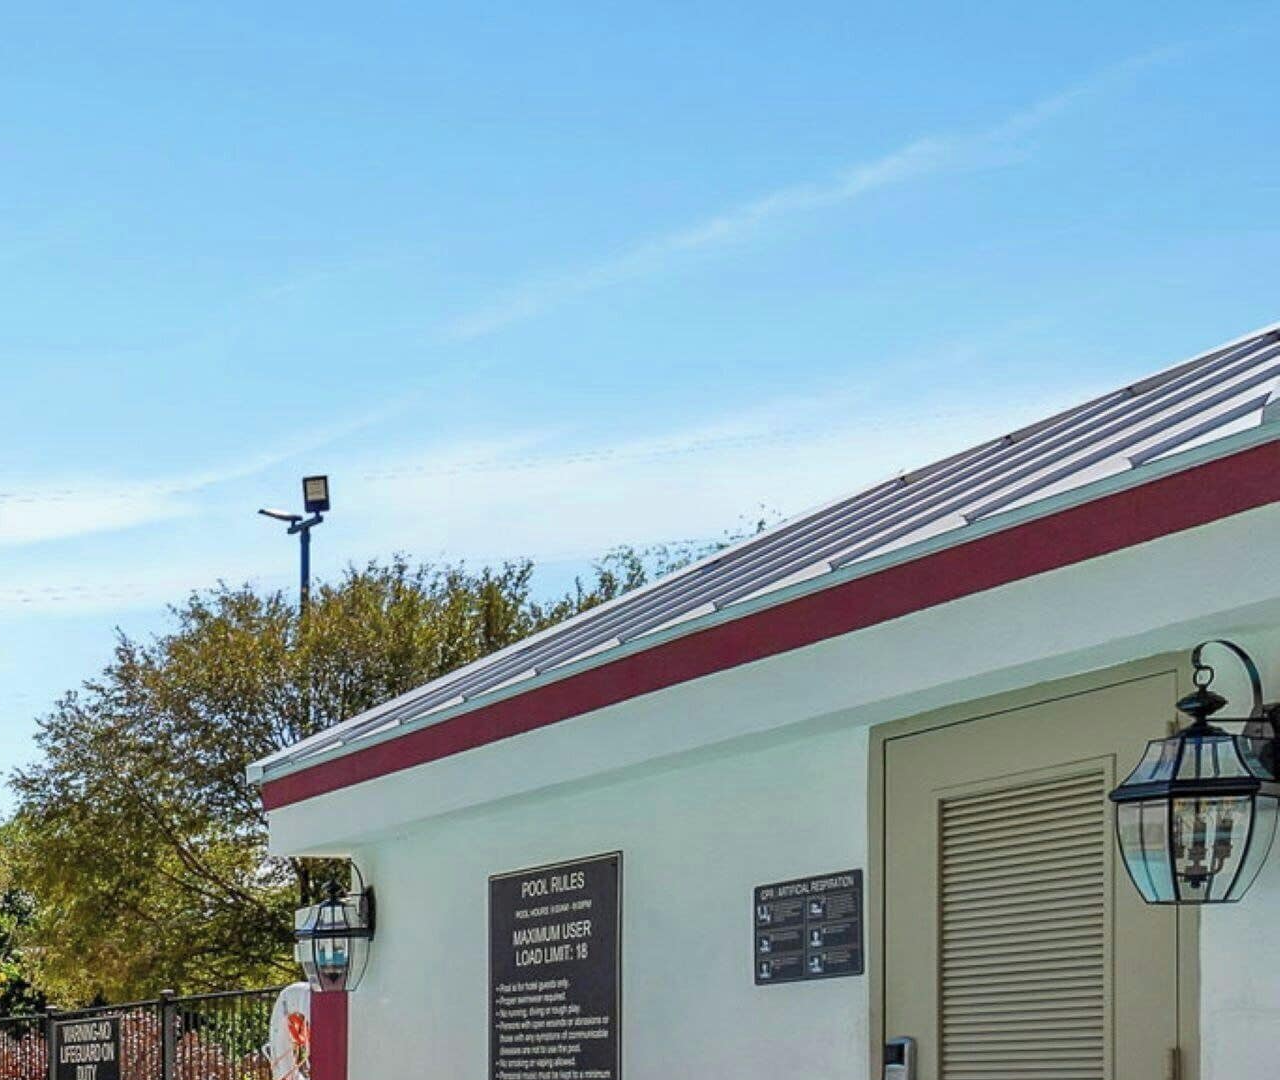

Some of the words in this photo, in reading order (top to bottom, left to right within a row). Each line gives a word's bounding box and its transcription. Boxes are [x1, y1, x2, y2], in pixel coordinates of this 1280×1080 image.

[521, 879, 549, 898] POOL
[551, 872, 585, 893] RULES
[512, 924, 560, 946] MAXIMUM
[562, 919, 592, 940] USER
[515, 947, 543, 966] LOAD
[544, 944, 573, 964] LIMIT:
[60, 1043, 101, 1064] LIFEGUARD
